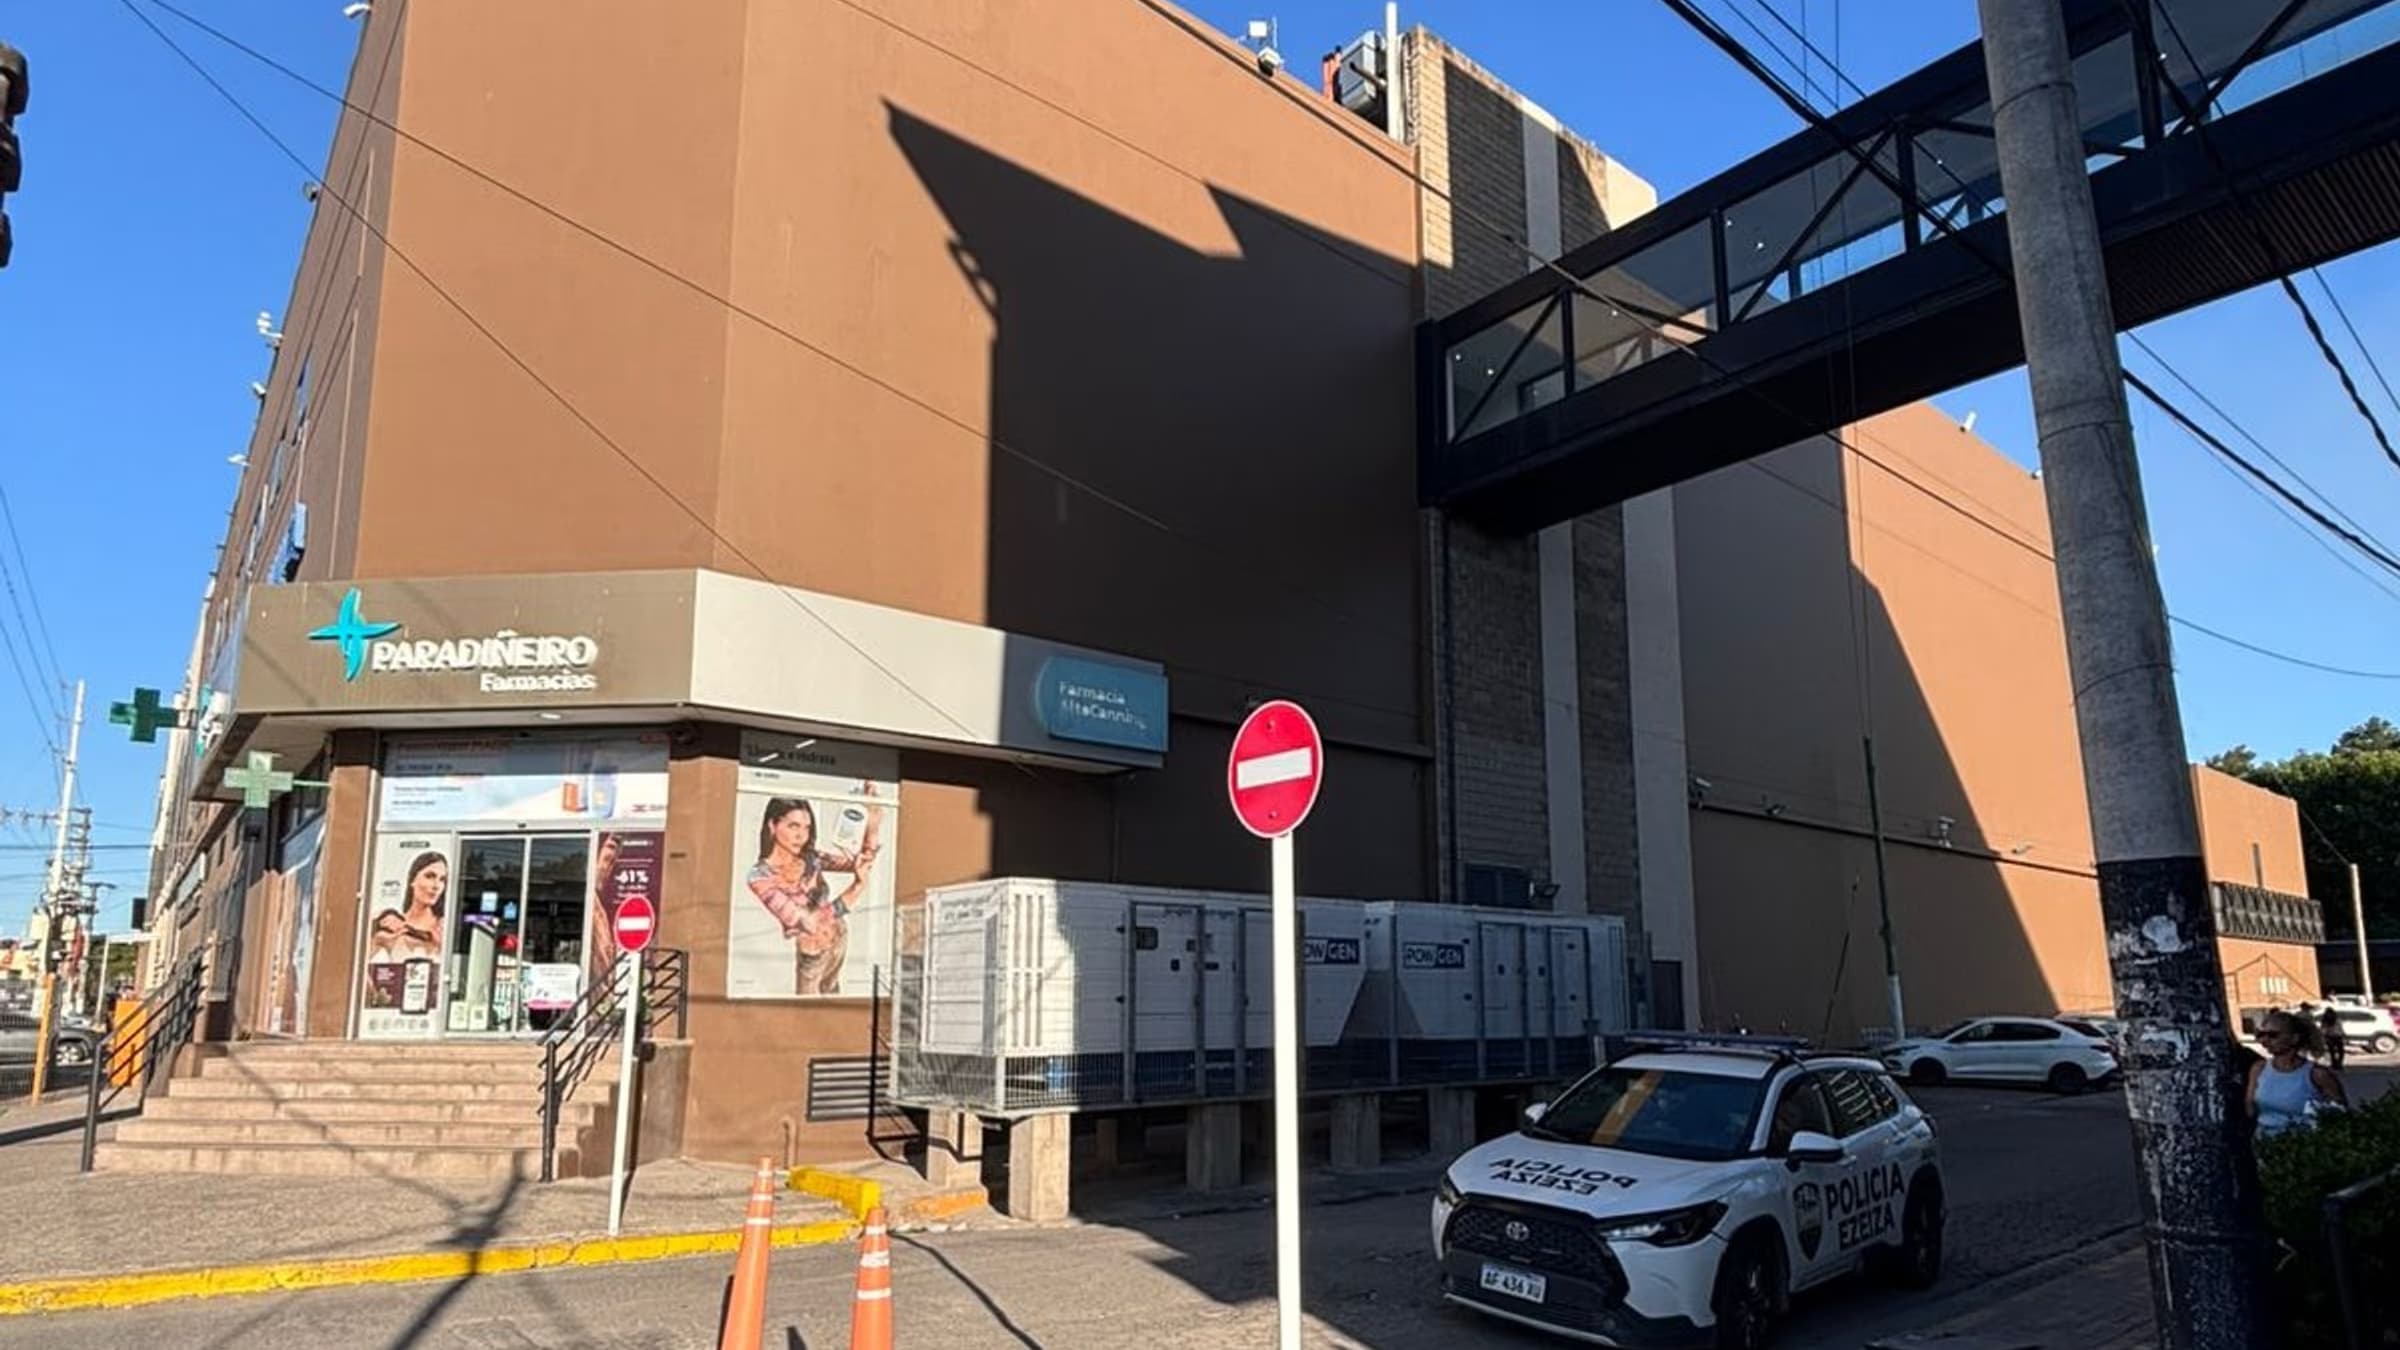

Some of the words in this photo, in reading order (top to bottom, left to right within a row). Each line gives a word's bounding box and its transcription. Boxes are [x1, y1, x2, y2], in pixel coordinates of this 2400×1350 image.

[372, 630, 598, 671] PARADIÑEIRO
[480, 669, 597, 691] Farmacias
[1060, 680, 1125, 704] Farmacia
[1824, 1162, 1905, 1220] POLICIA
[1838, 1201, 1895, 1250] EZEIZA
